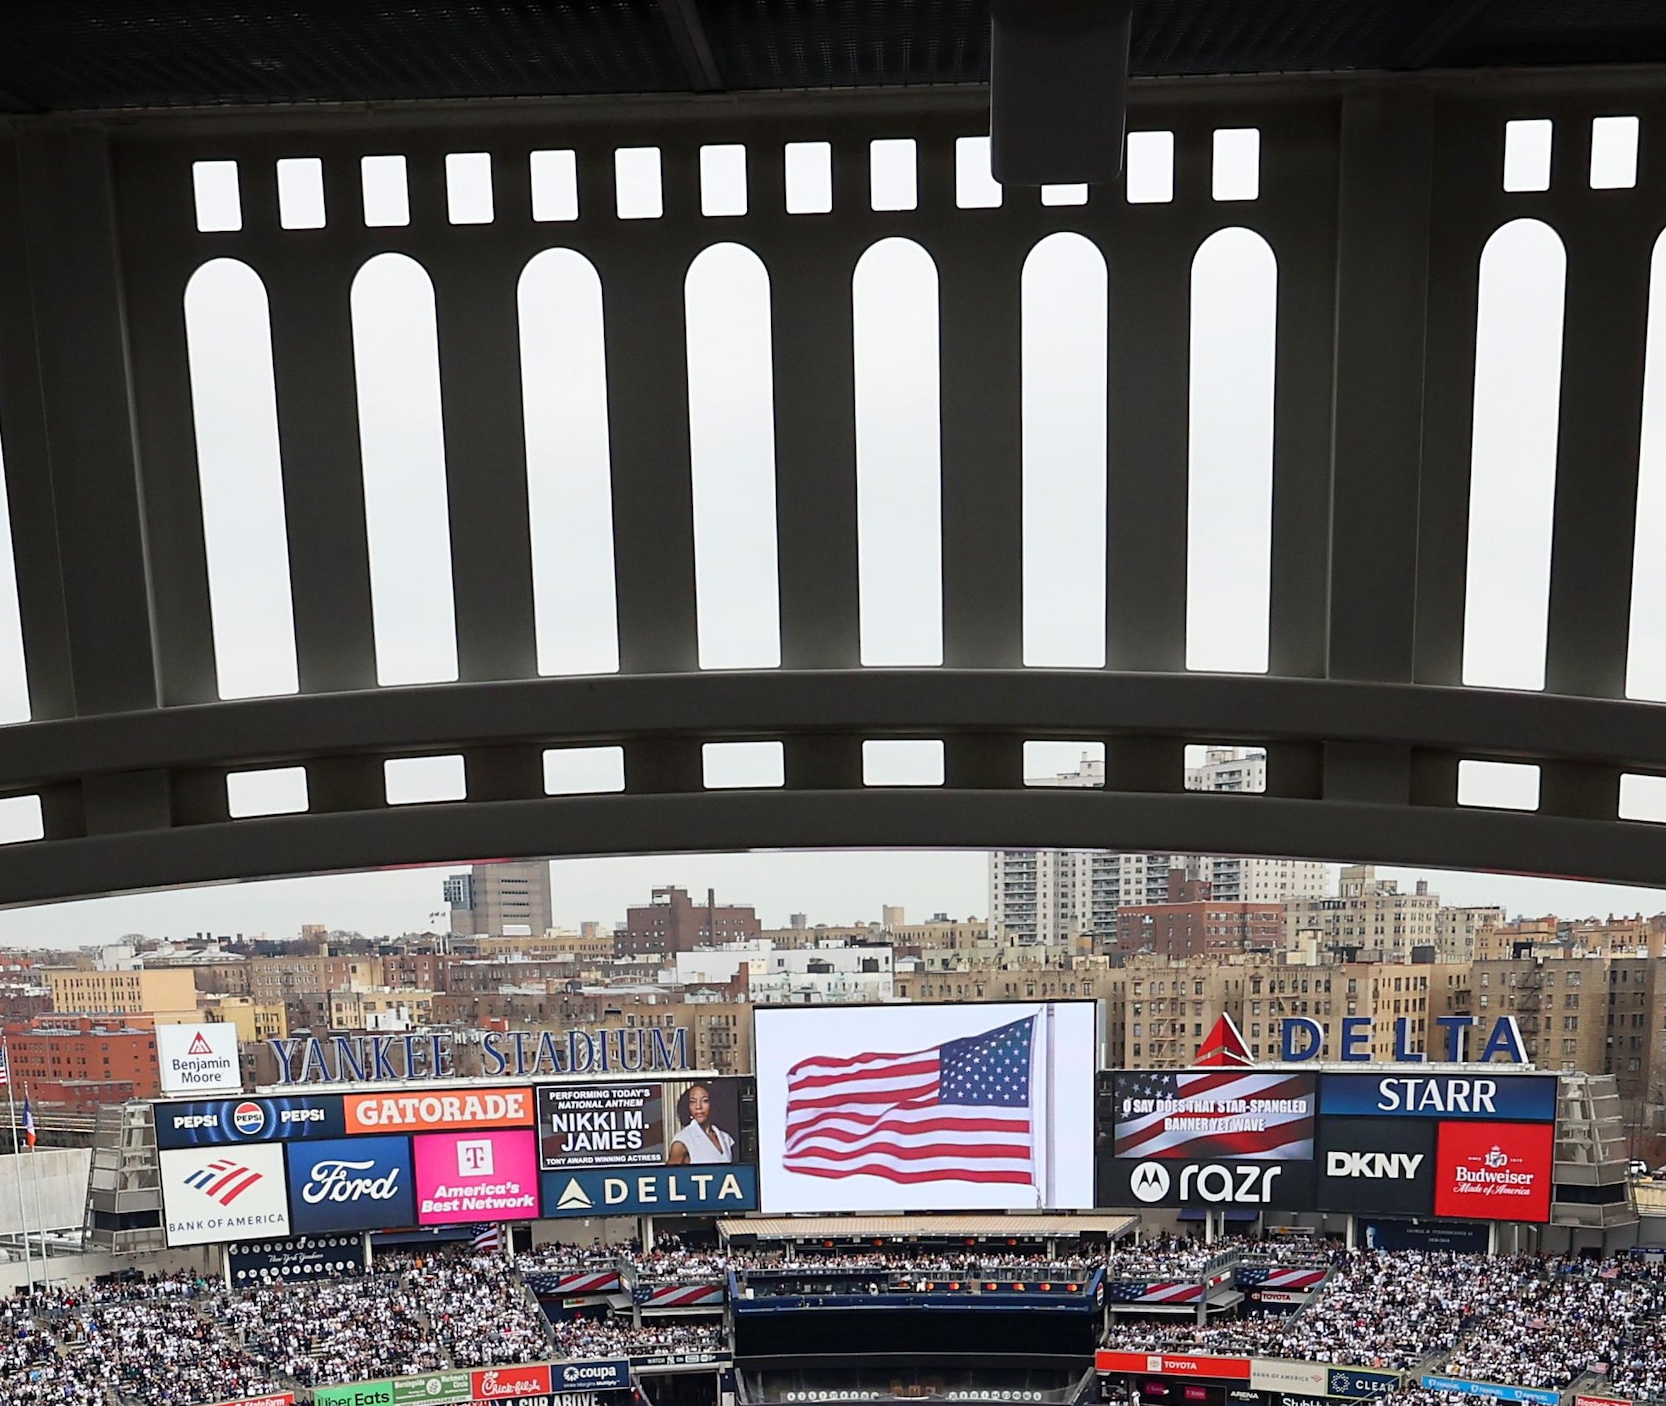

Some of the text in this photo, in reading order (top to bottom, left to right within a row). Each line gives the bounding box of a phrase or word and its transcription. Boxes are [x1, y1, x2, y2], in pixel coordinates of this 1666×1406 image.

[1281, 1015, 1529, 1063] DELTA
[267, 1027, 690, 1084] YANKEE STADIUM
[172, 1057, 231, 1072] Benjamin
[181, 1072, 222, 1083] Moore
[549, 1088, 651, 1101] PERFORMING TODAY'S
[1378, 1078, 1496, 1113] STARR
[356, 1093, 525, 1127] GATORADE
[557, 1098, 644, 1109] NATIONAL ANTHEM
[1123, 1099, 1307, 1114] O SAY DOES THAT STAR-SPANGLED
[173, 1114, 218, 1129] PEPSI
[236, 1113, 263, 1122] PEPSI
[281, 1109, 325, 1123] PEPSI
[552, 1110, 650, 1133] NIKKI M.
[1164, 1118, 1265, 1132] BANNER YET WAVE
[560, 1131, 643, 1152] JAMES
[545, 1154, 662, 1166] TONY AWARD WINNING ACTRESS
[1327, 1151, 1424, 1179] DKNY
[303, 1160, 400, 1204] Ford
[1455, 1166, 1533, 1185] Budweiser
[434, 1182, 520, 1198] America's
[604, 1174, 744, 1204] DELTA
[1180, 1164, 1281, 1203] razr
[1453, 1182, 1531, 1196] Made of America
[421, 1194, 535, 1214] Best Network
[169, 1213, 285, 1232] BANK OF AMERICA
[1262, 1293, 1291, 1301] TOYOTA
[580, 1366, 616, 1381] coupa
[1164, 1361, 1197, 1371] TOYOTA
[1280, 1374, 1309, 1382] AMERICA
[1355, 1379, 1395, 1392] CLEAR
[354, 1392, 390, 1406] Eats
[1230, 1391, 1259, 1400] ARENA
